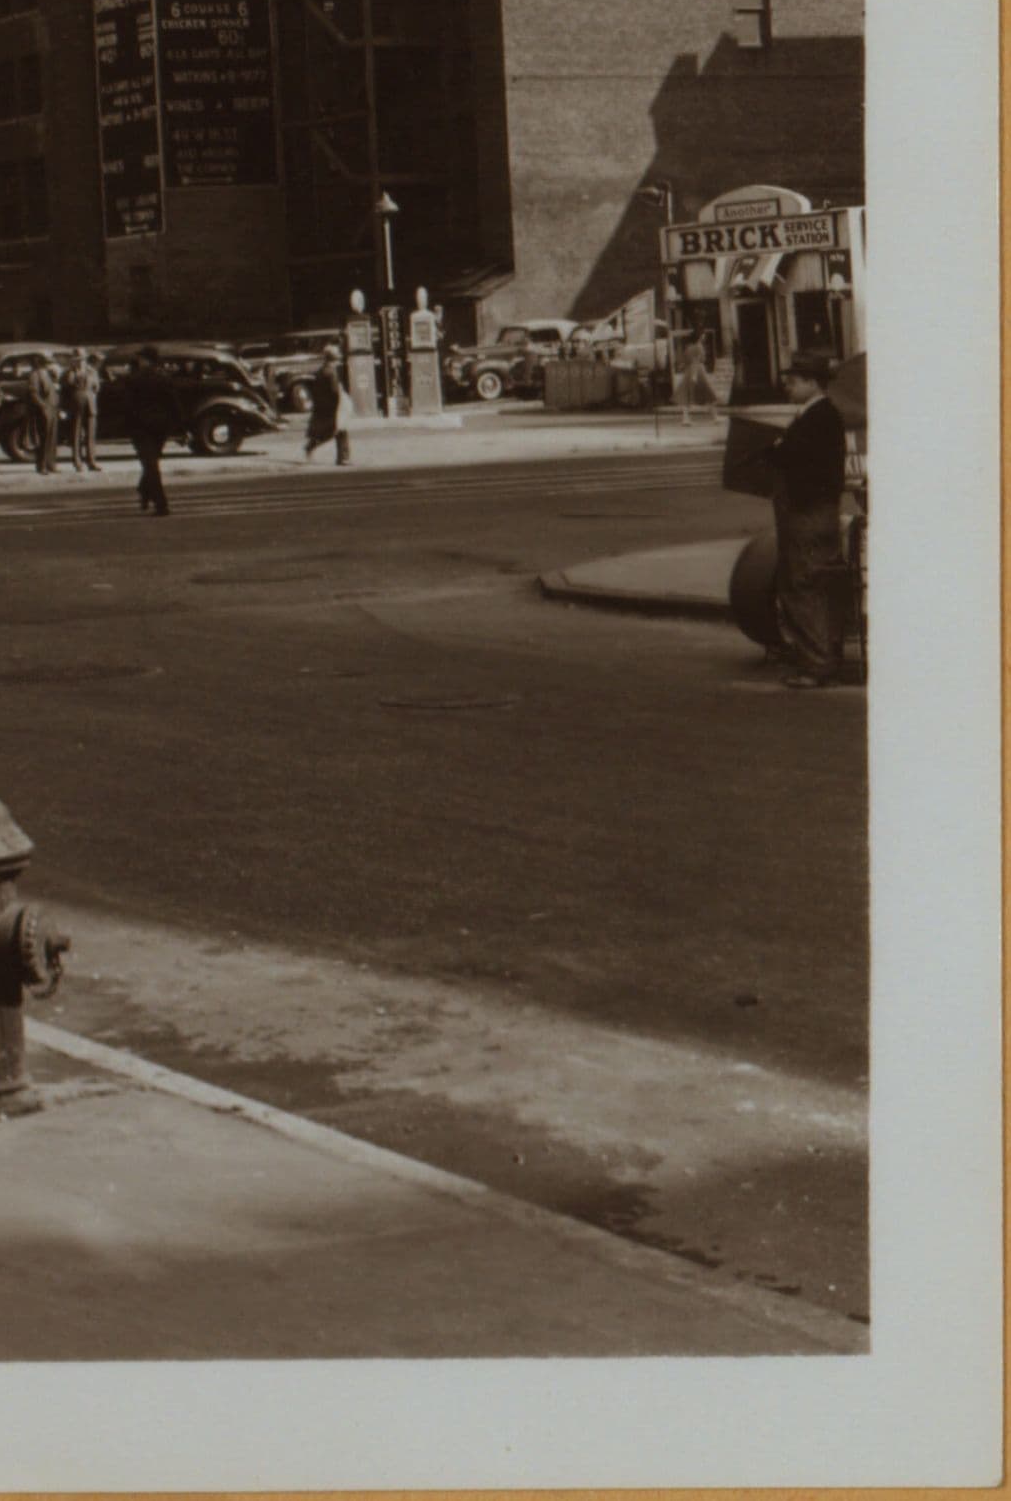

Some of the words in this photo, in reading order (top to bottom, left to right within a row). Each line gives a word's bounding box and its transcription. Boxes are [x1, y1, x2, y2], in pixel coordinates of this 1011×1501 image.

[170, 1, 182, 18] 6
[237, 0, 249, 18] 6
[783, 218, 829, 234] SERVICE
[680, 224, 782, 256] BRICK
[785, 232, 830, 247] STATION
